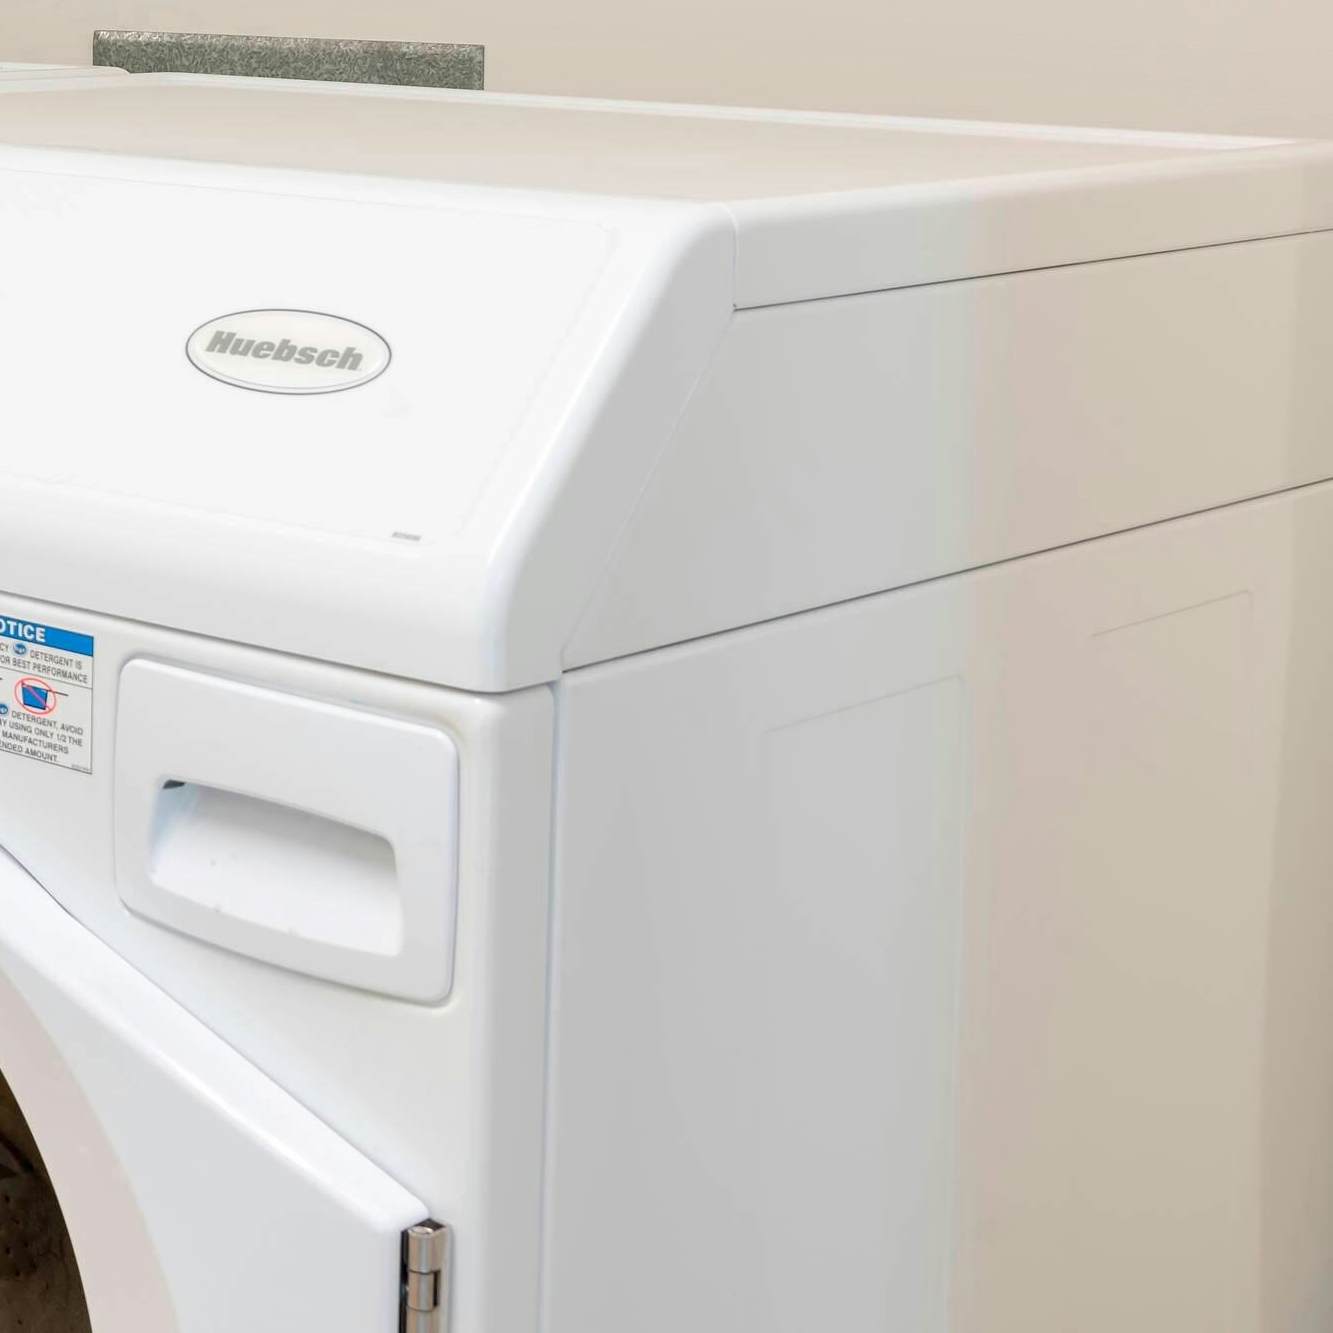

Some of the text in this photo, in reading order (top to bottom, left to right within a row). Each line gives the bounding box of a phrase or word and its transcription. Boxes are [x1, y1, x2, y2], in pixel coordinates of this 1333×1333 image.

[205, 330, 364, 371] Huebsch
[12, 657, 31, 669] BEST
[33, 662, 87, 684] PERFORMANCE
[30, 649, 73, 667] DETERGENT
[76, 660, 82, 670] IS
[9, 722, 32, 734] USING
[34, 727, 54, 739] ONLY
[68, 736, 83, 747] THE
[60, 723, 83, 735] AVOID
[2, 730, 69, 755] MANUFACTURERS
